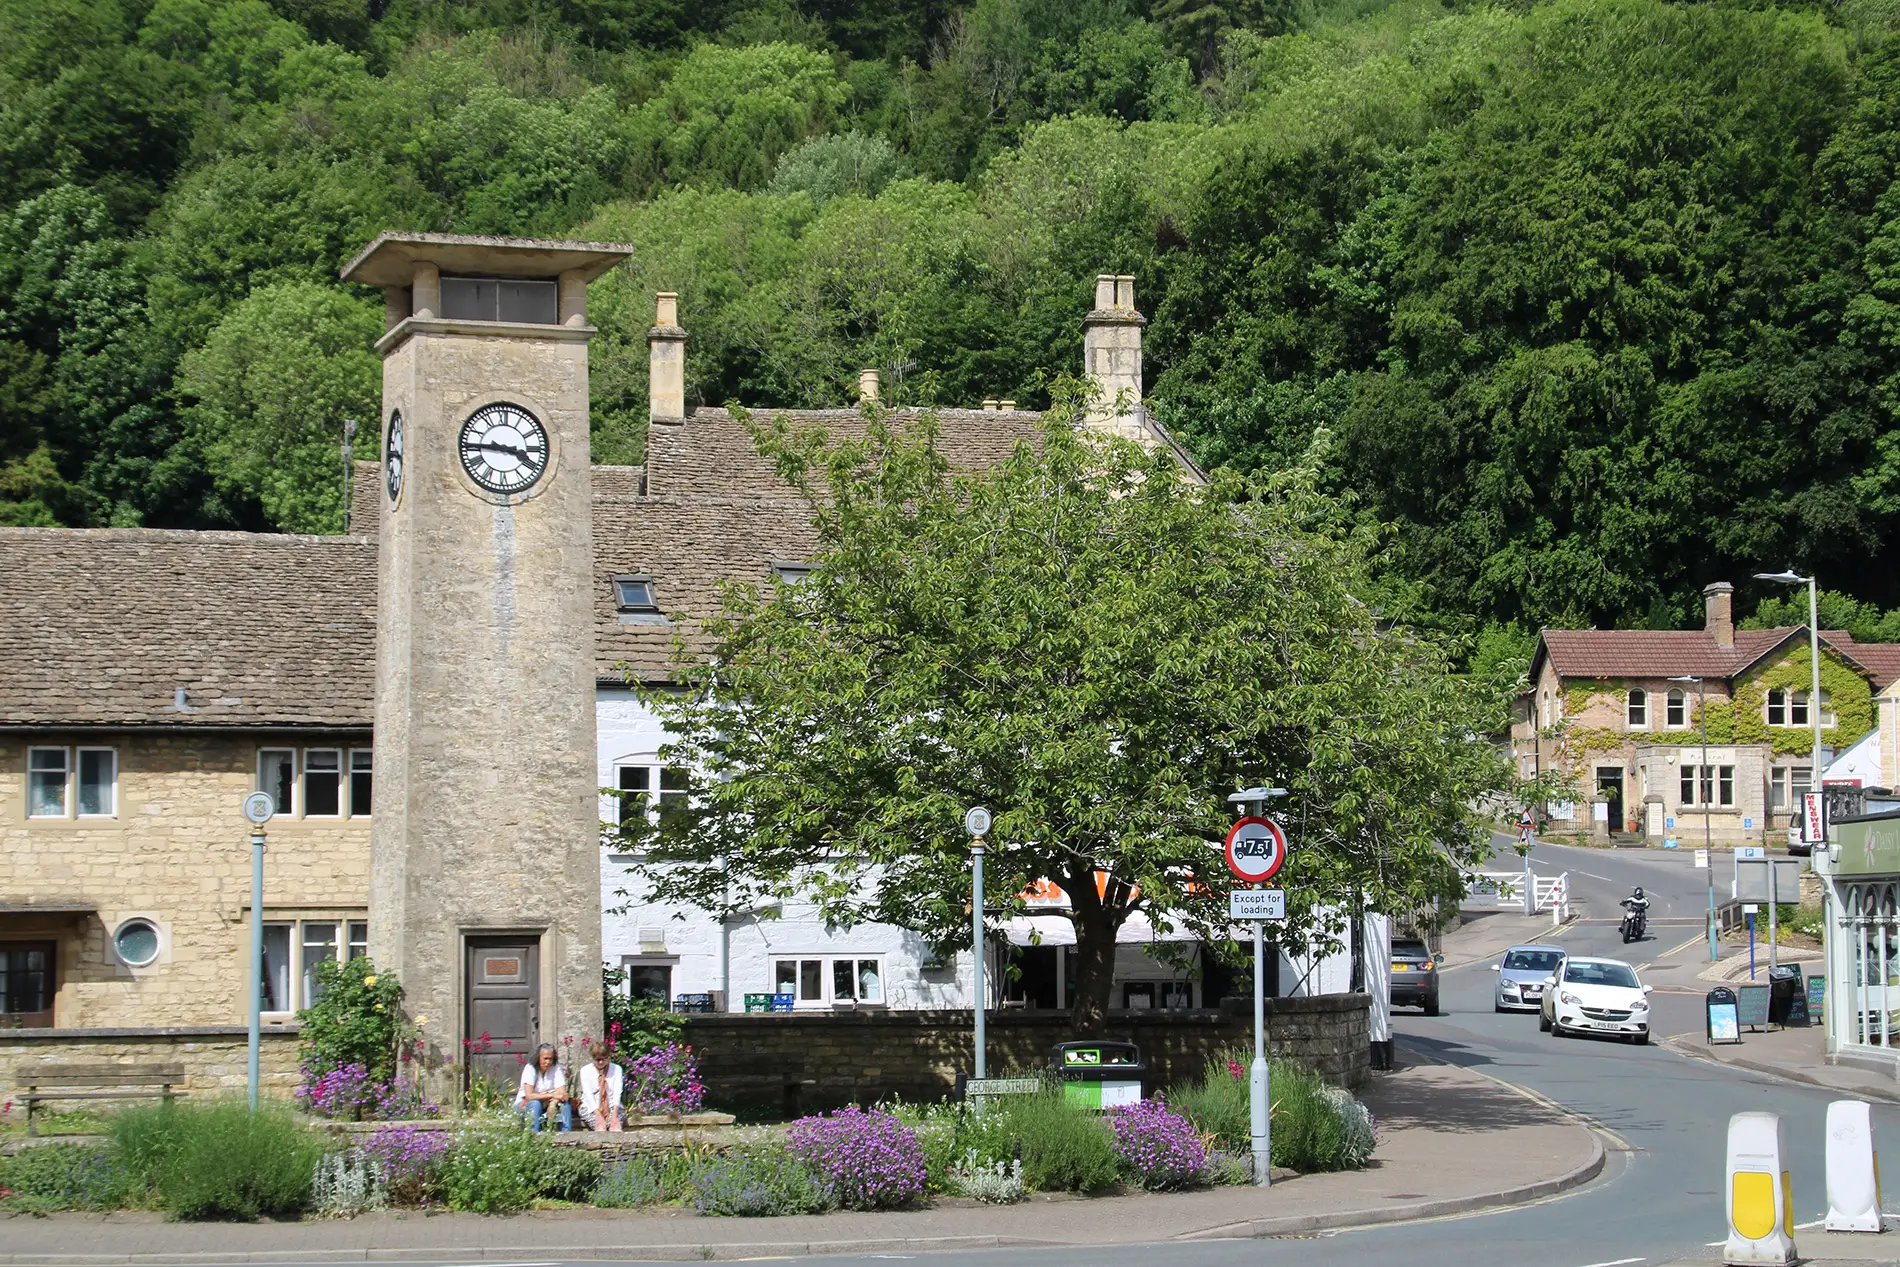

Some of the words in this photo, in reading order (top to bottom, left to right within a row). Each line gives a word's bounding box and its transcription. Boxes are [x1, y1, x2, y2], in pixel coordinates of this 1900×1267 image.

[1805, 794, 1821, 839] MENSWEAR
[1234, 894, 1264, 904] Except
[1268, 894, 1281, 903] for
[1241, 905, 1274, 915] loading
[968, 1081, 1000, 1093] GEORGE
[1005, 1080, 1038, 1092] STREET
